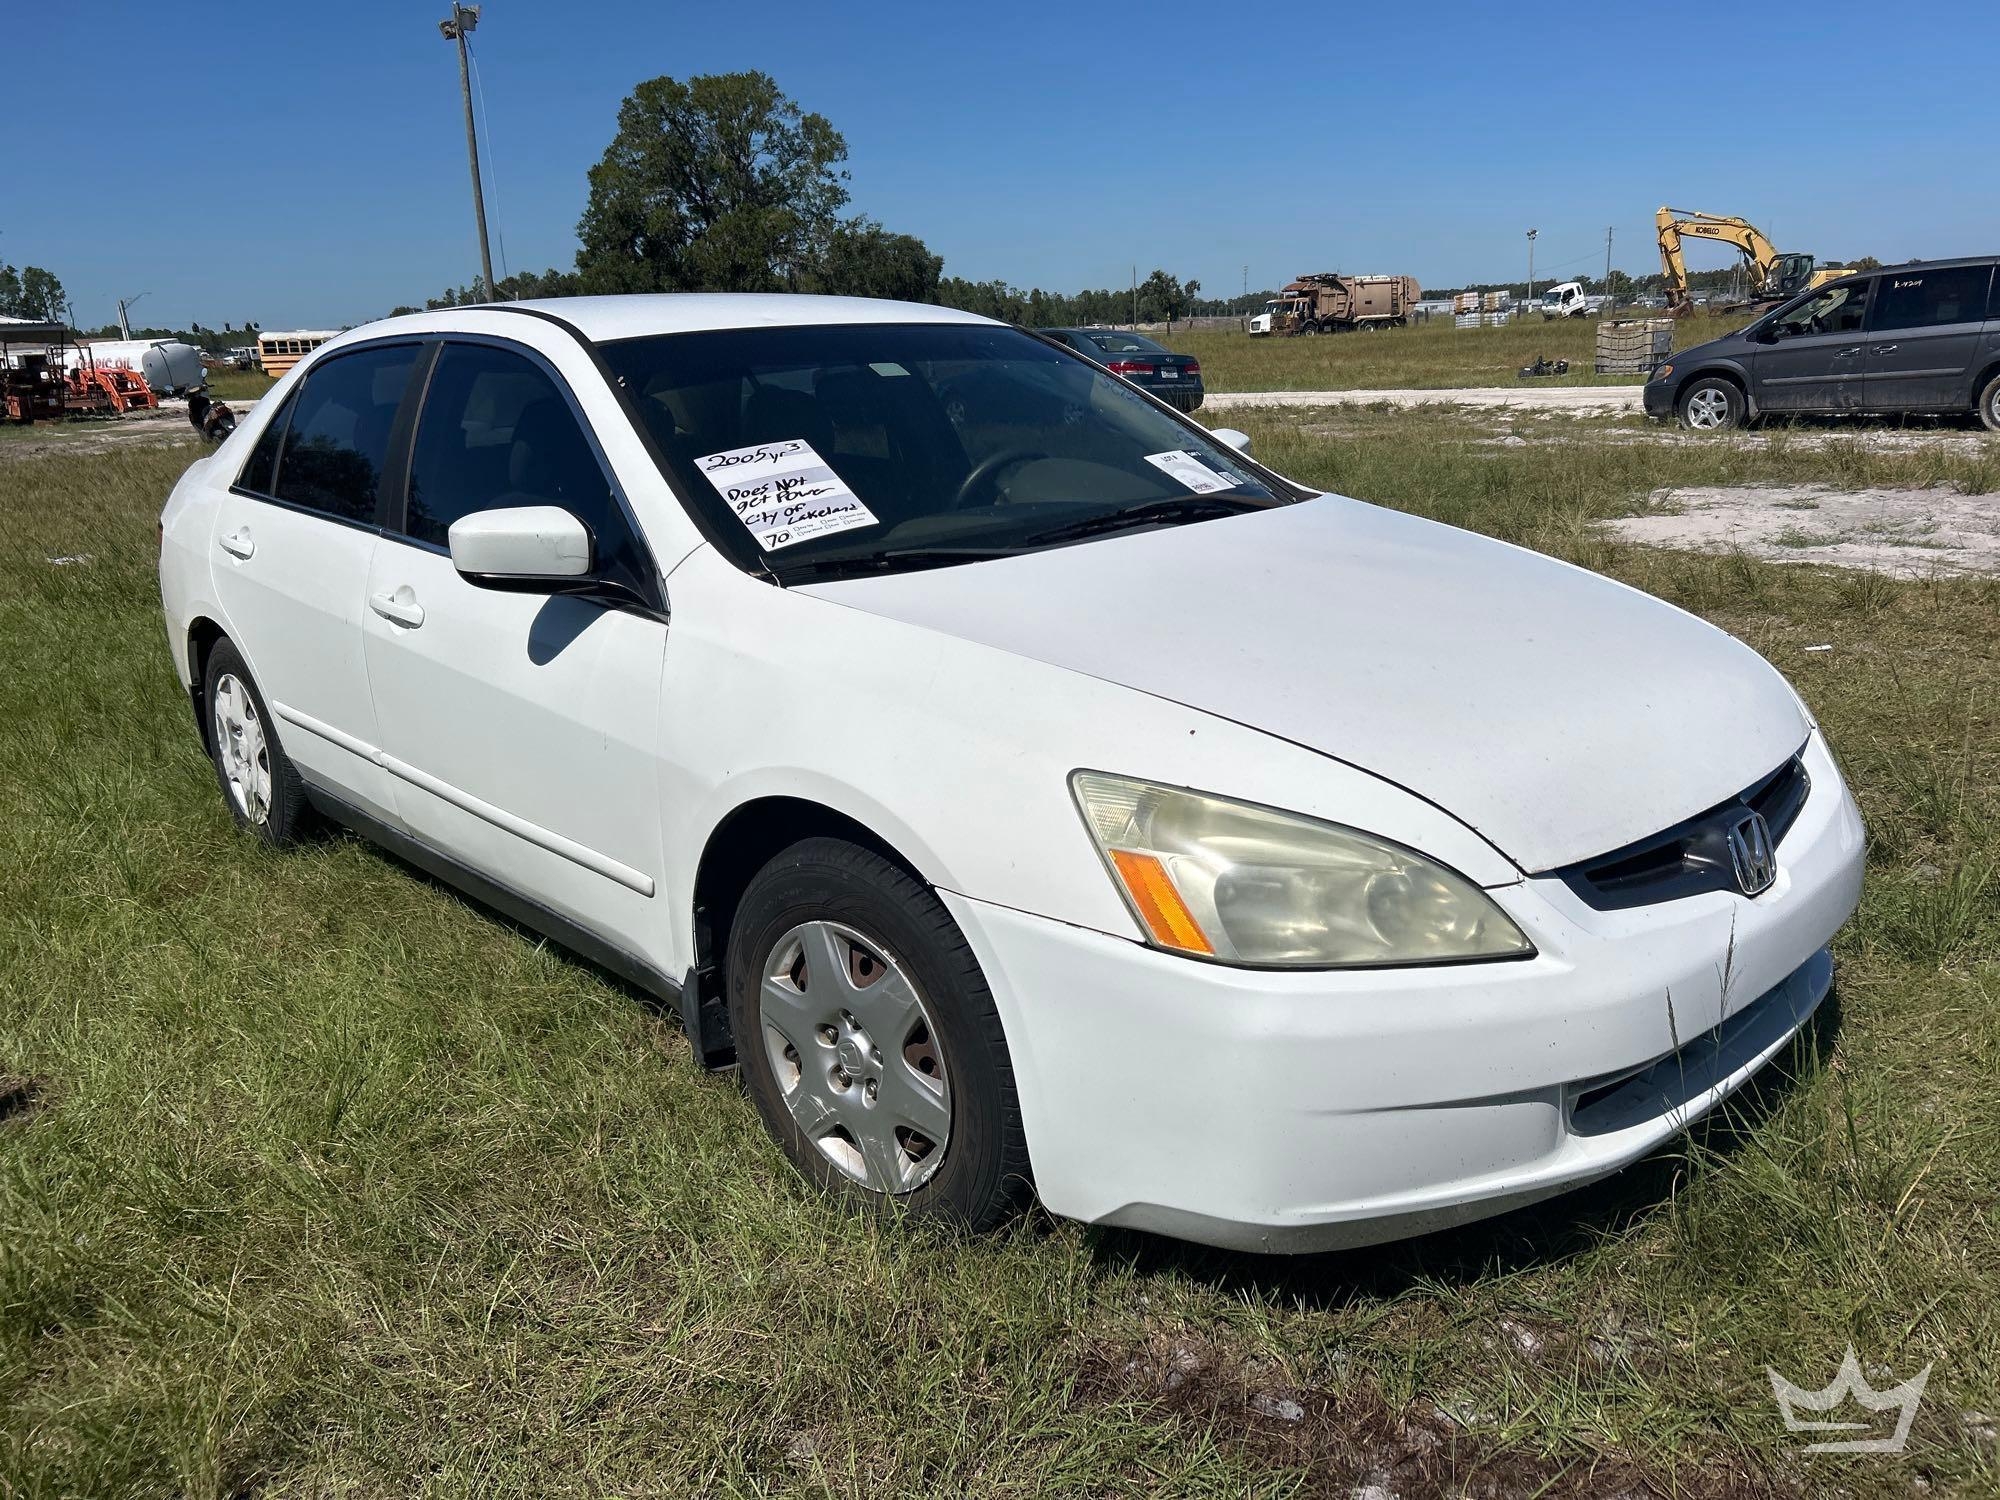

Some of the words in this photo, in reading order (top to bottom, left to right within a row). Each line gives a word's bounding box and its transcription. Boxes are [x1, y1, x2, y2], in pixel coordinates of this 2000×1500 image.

[1695, 226, 1720, 235] KOBELCO
[115, 356, 134, 370] OIL
[727, 483, 769, 502] Does
[745, 511, 778, 526] City
[766, 531, 790, 548] 70
